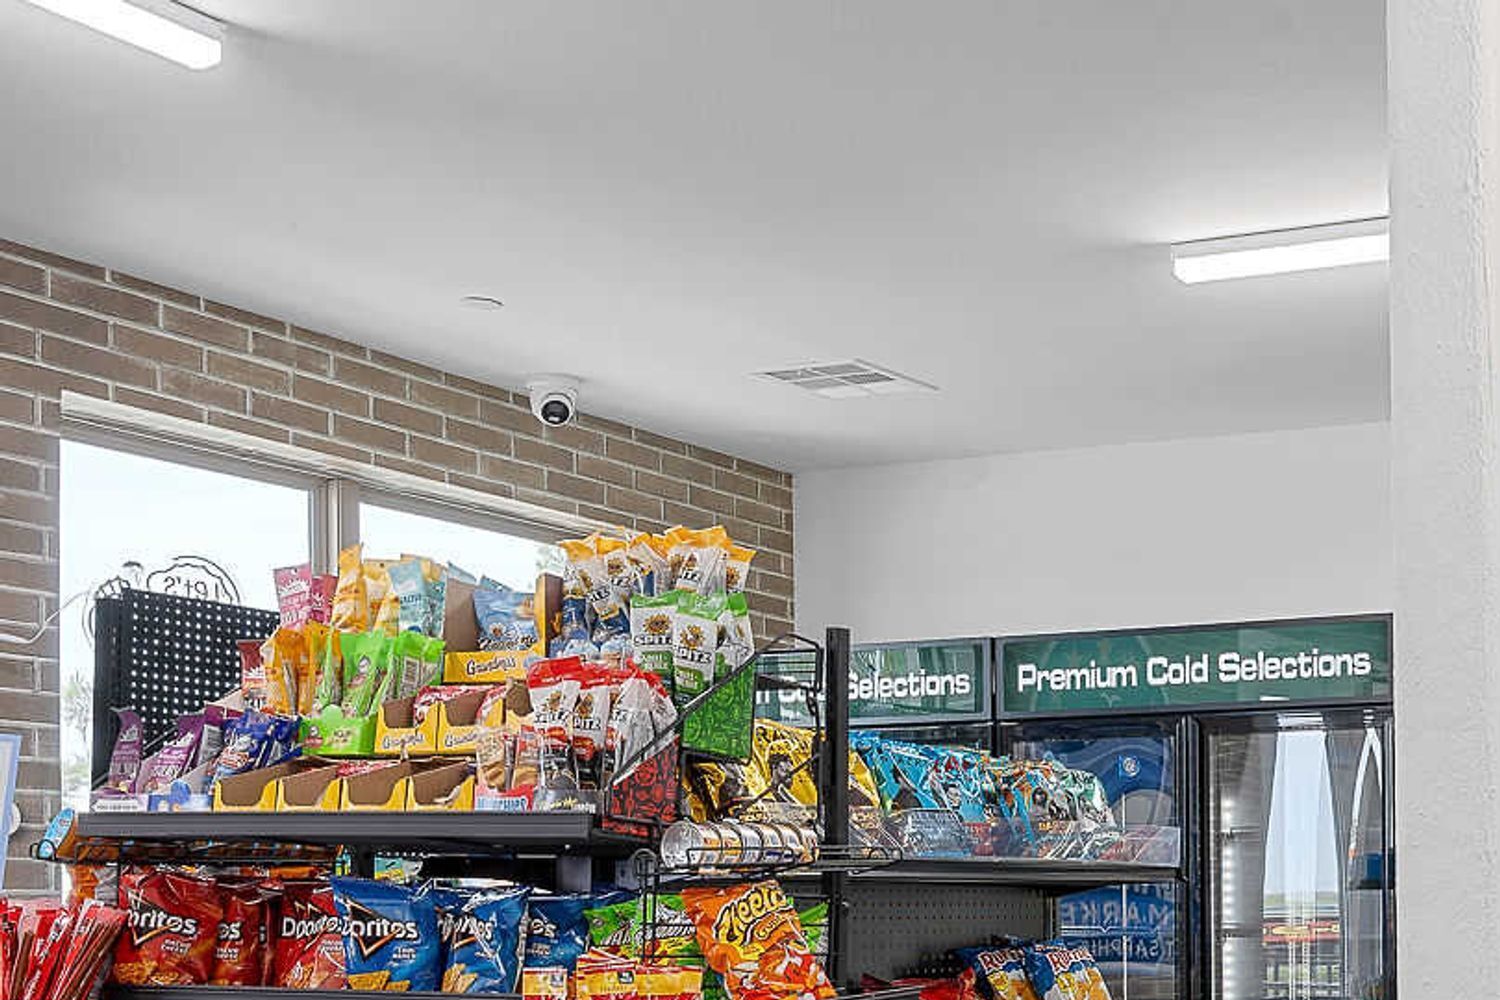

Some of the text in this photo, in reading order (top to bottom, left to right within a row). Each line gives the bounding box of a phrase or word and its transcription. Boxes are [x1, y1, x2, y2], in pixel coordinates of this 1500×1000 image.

[848, 672, 971, 700] Selections
[1017, 648, 1372, 693] Premium Cold Selections
